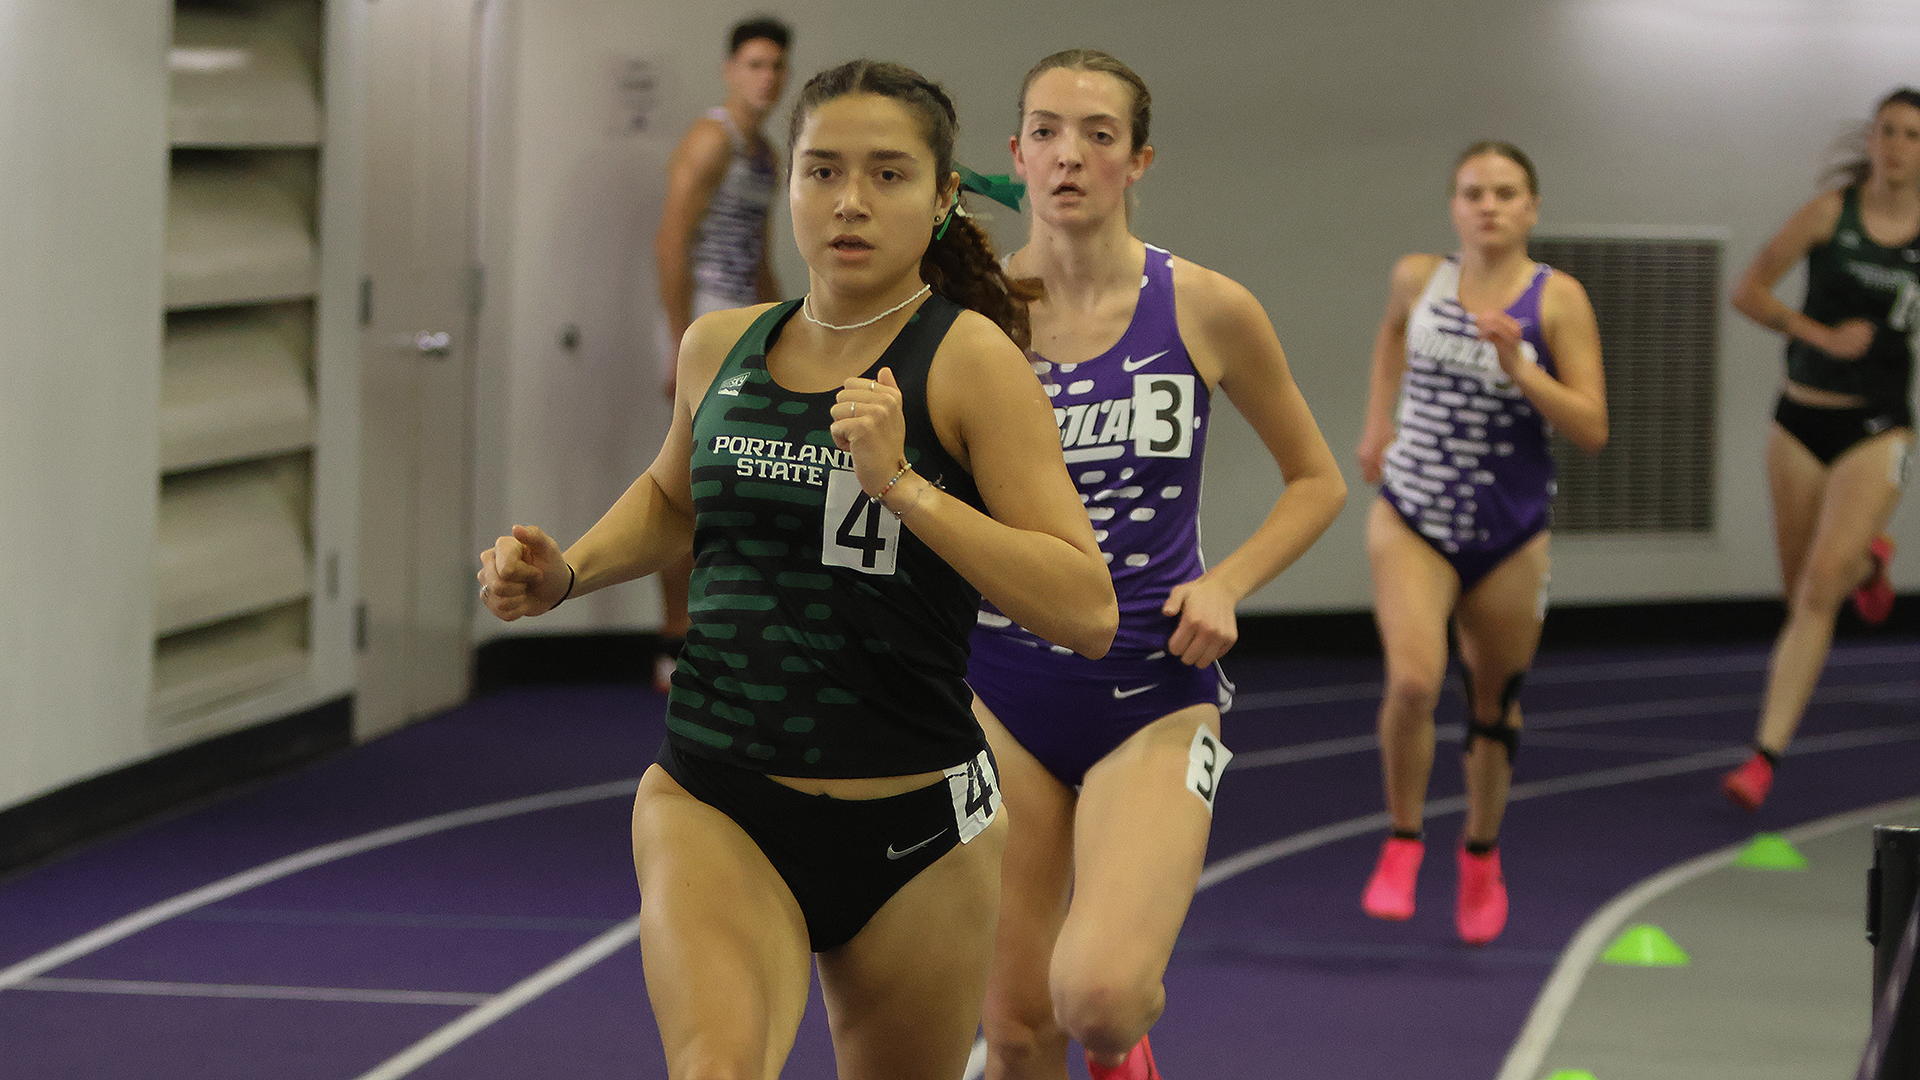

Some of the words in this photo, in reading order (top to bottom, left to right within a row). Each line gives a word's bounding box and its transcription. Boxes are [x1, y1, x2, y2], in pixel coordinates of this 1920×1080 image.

[1150, 379, 1183, 453] 3
[736, 457, 823, 486] STATE
[836, 489, 886, 568] 4
[964, 758, 994, 819] 4
[1196, 735, 1218, 802] 3
